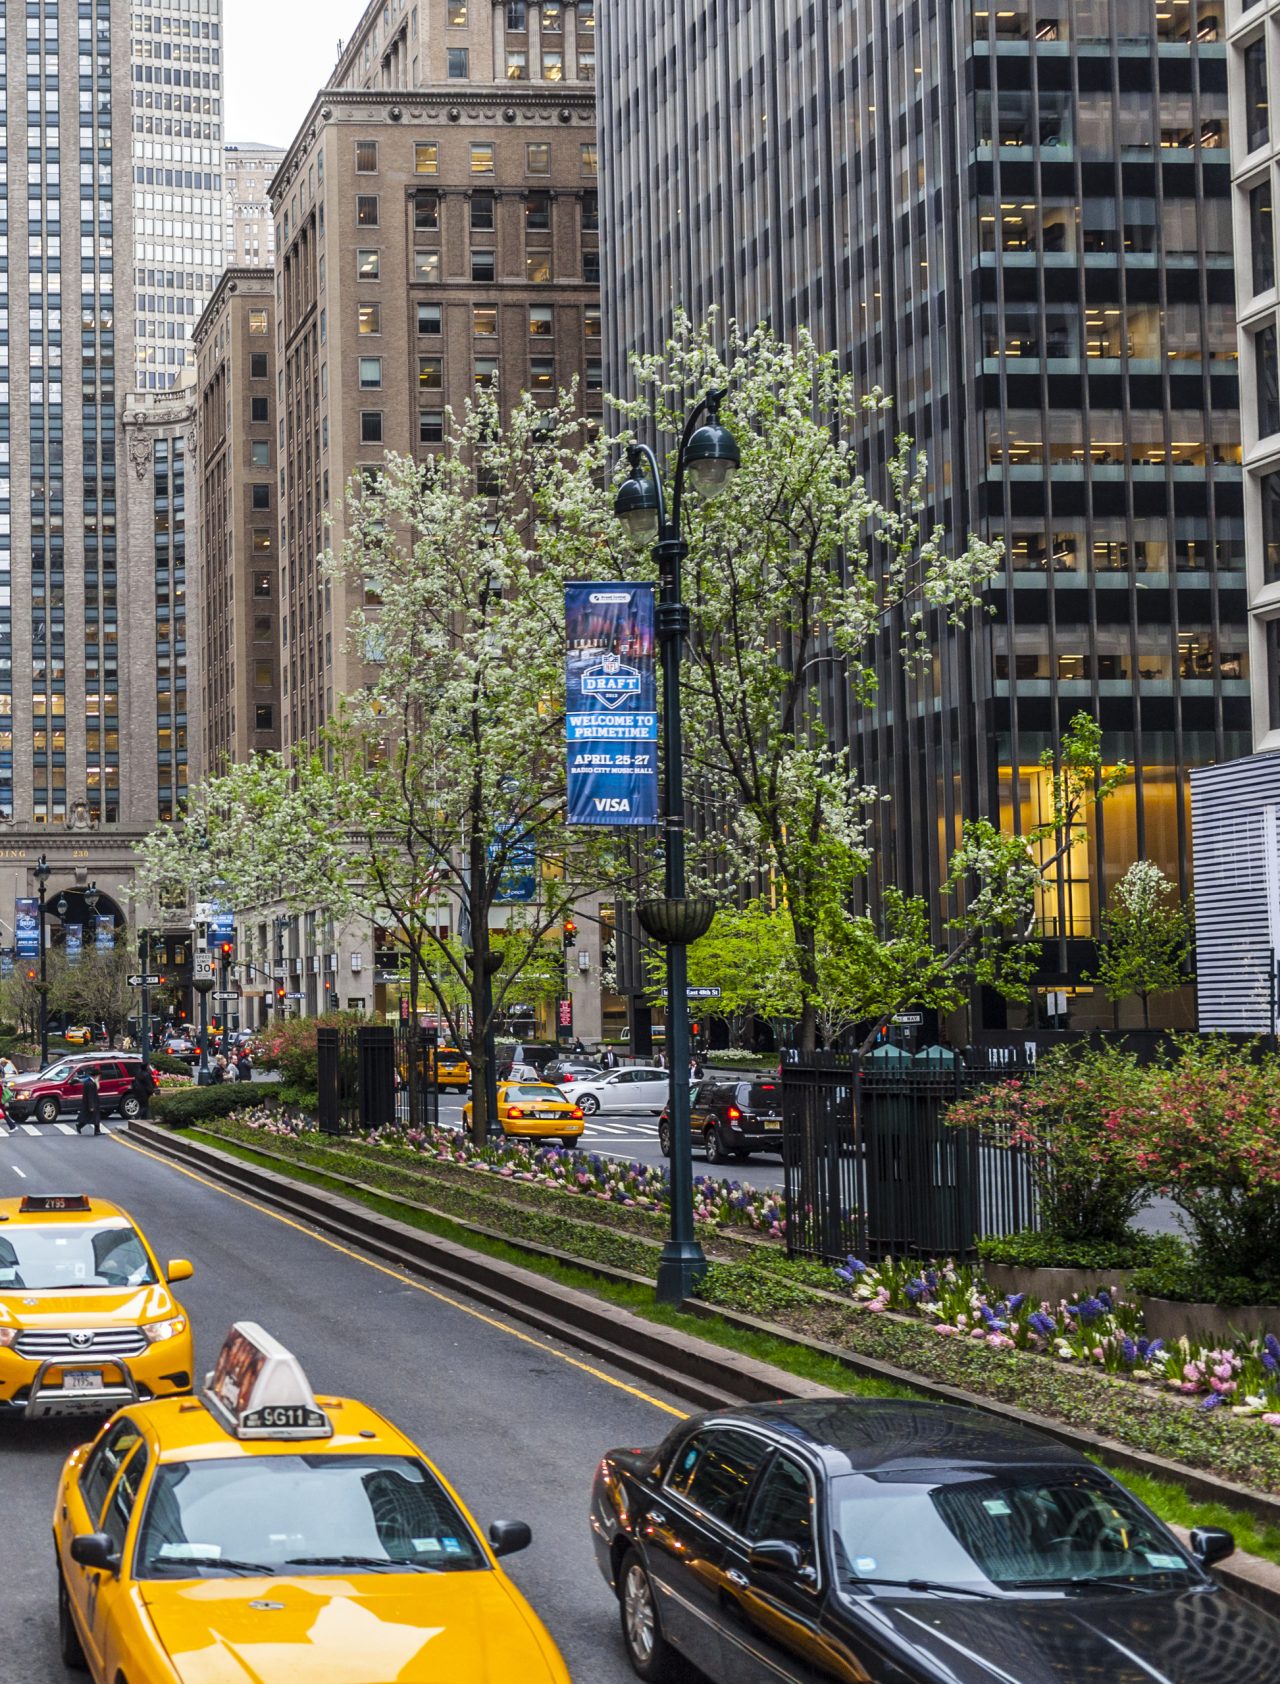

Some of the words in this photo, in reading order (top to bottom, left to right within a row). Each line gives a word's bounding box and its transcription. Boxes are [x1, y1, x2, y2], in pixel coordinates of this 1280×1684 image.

[586, 679, 636, 689] DRAFT
[570, 716, 634, 726] WELCOME
[636, 716, 654, 726] TO
[575, 728, 649, 737] PRIMETIME
[574, 755, 613, 765] APRIL
[615, 755, 650, 765] 25-27
[593, 798, 631, 812] VISA
[196, 964, 210, 972] 30
[45, 1198, 65, 1208] 2Y95
